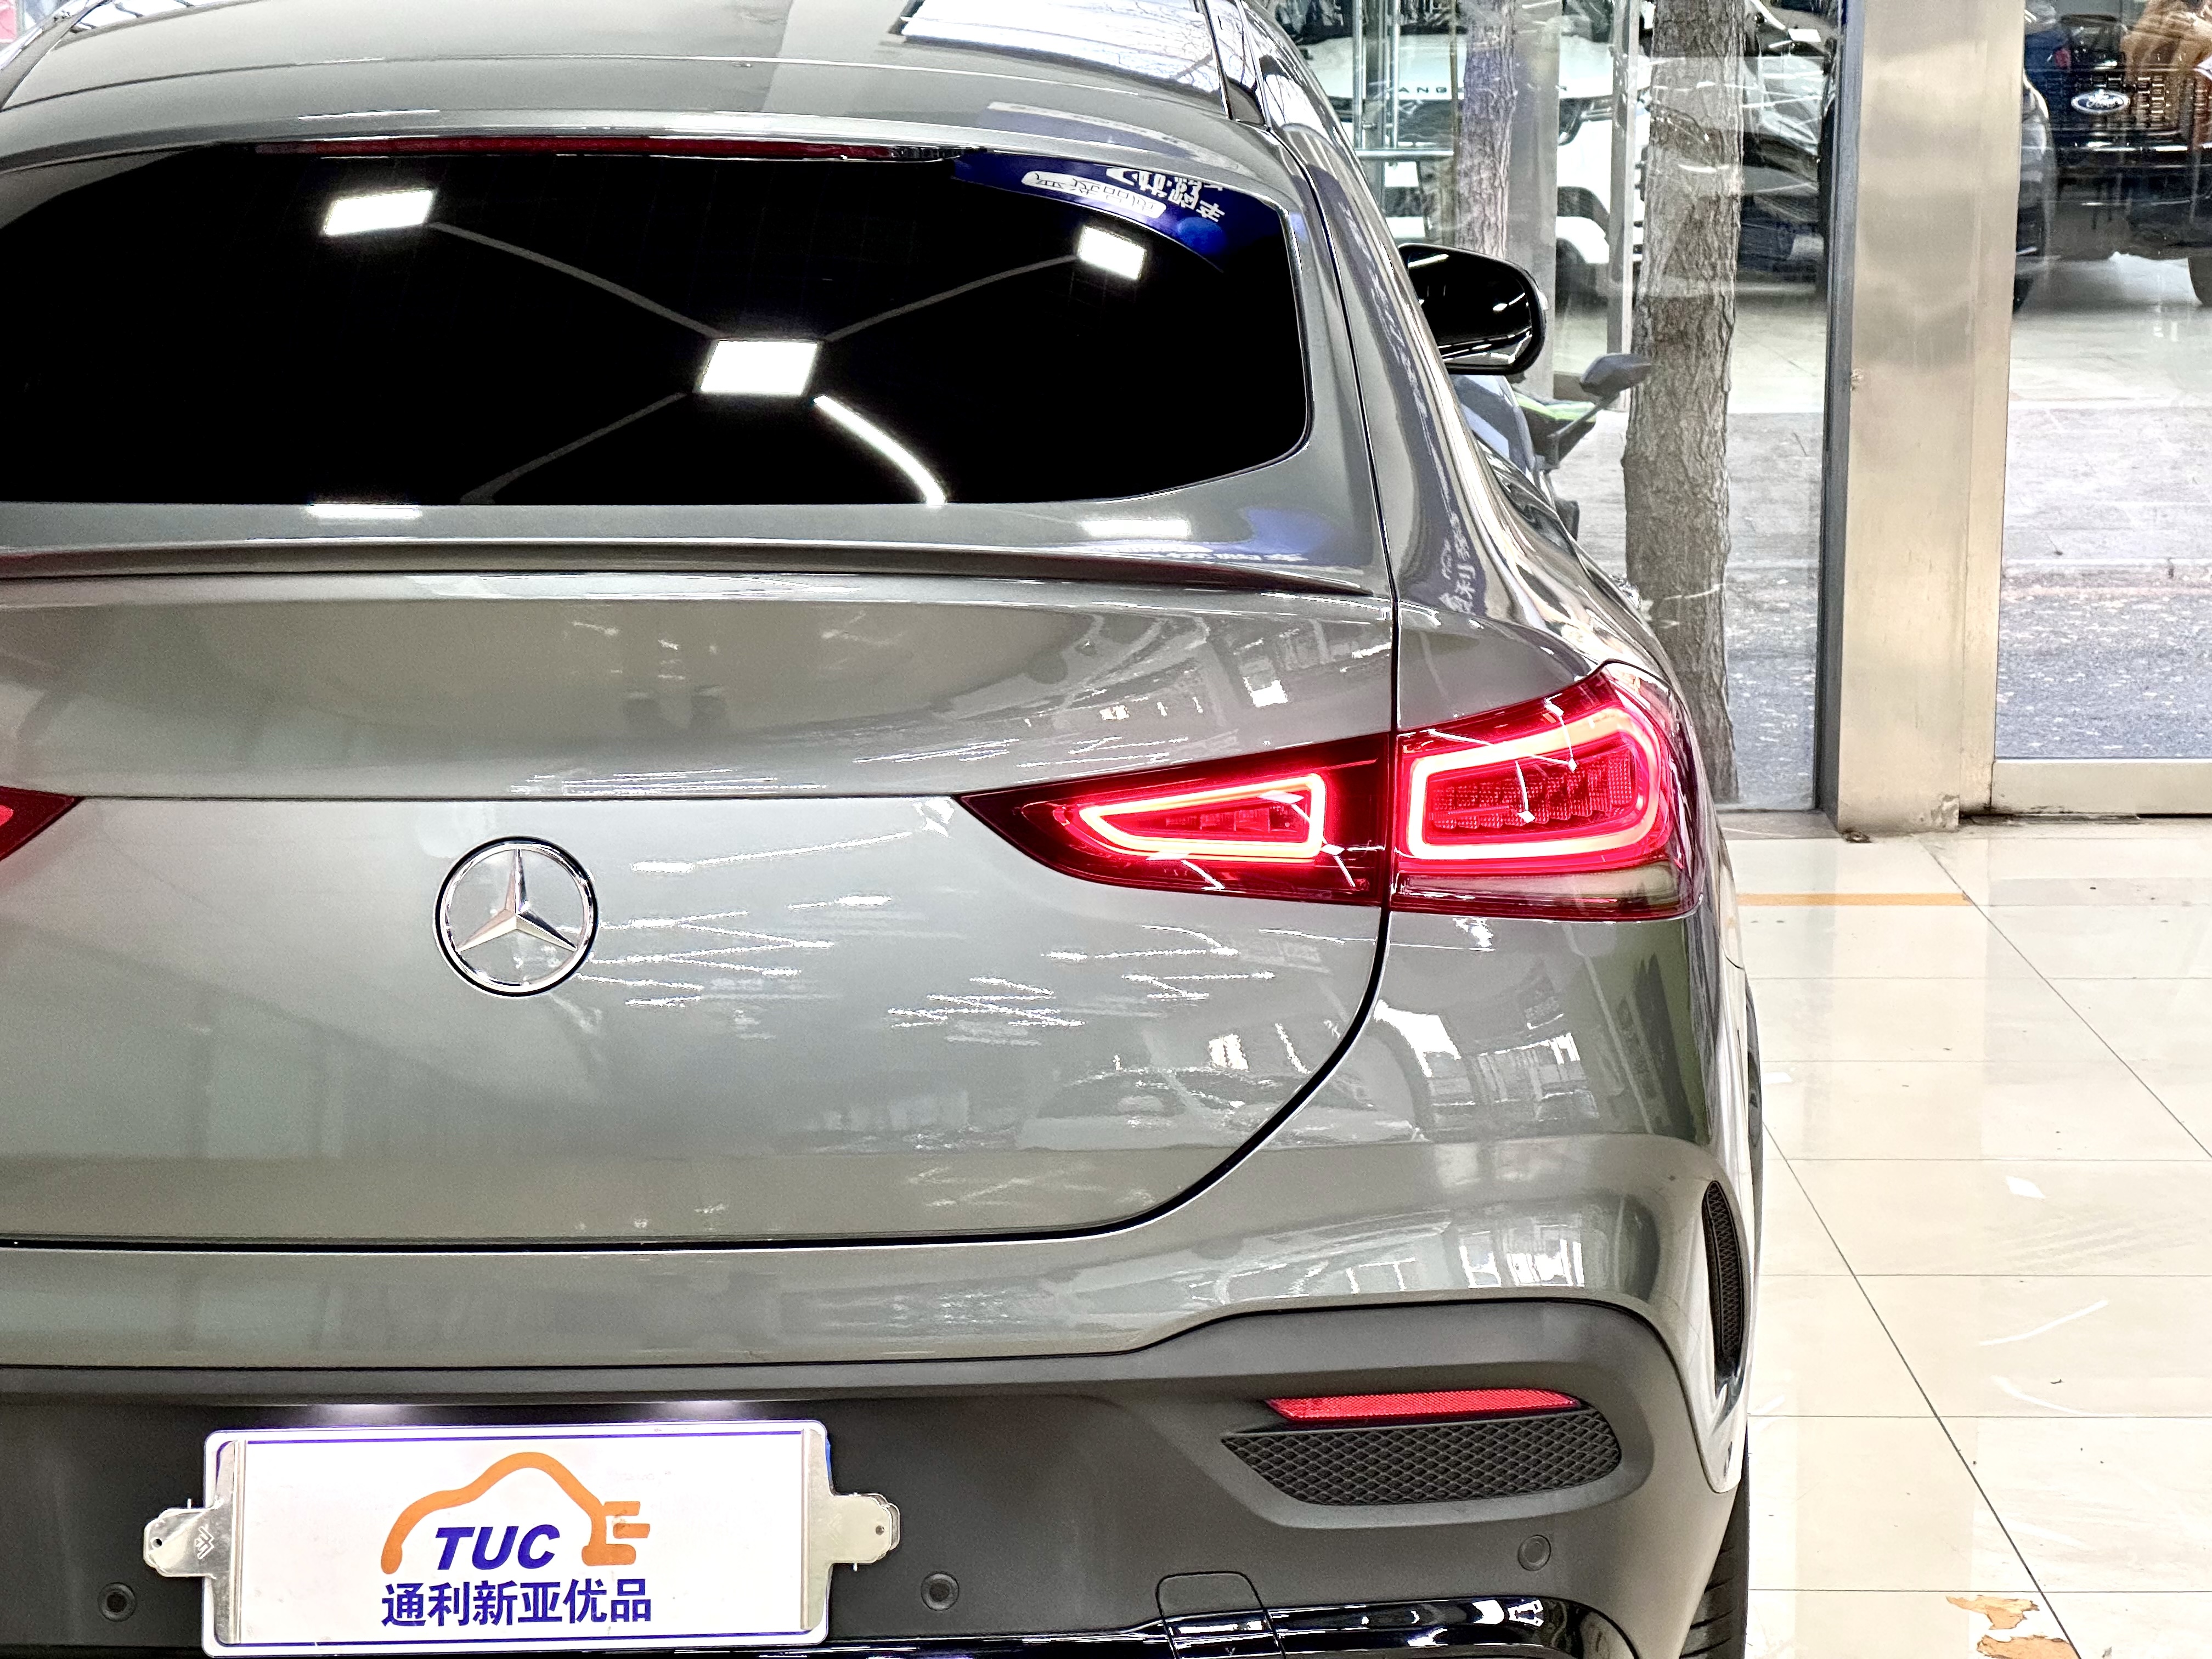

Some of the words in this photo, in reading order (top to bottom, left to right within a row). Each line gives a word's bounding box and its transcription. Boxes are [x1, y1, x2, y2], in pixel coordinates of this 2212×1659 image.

[435, 1524, 560, 1570] TUC
[381, 1578, 652, 1627] 通利新亚优品
